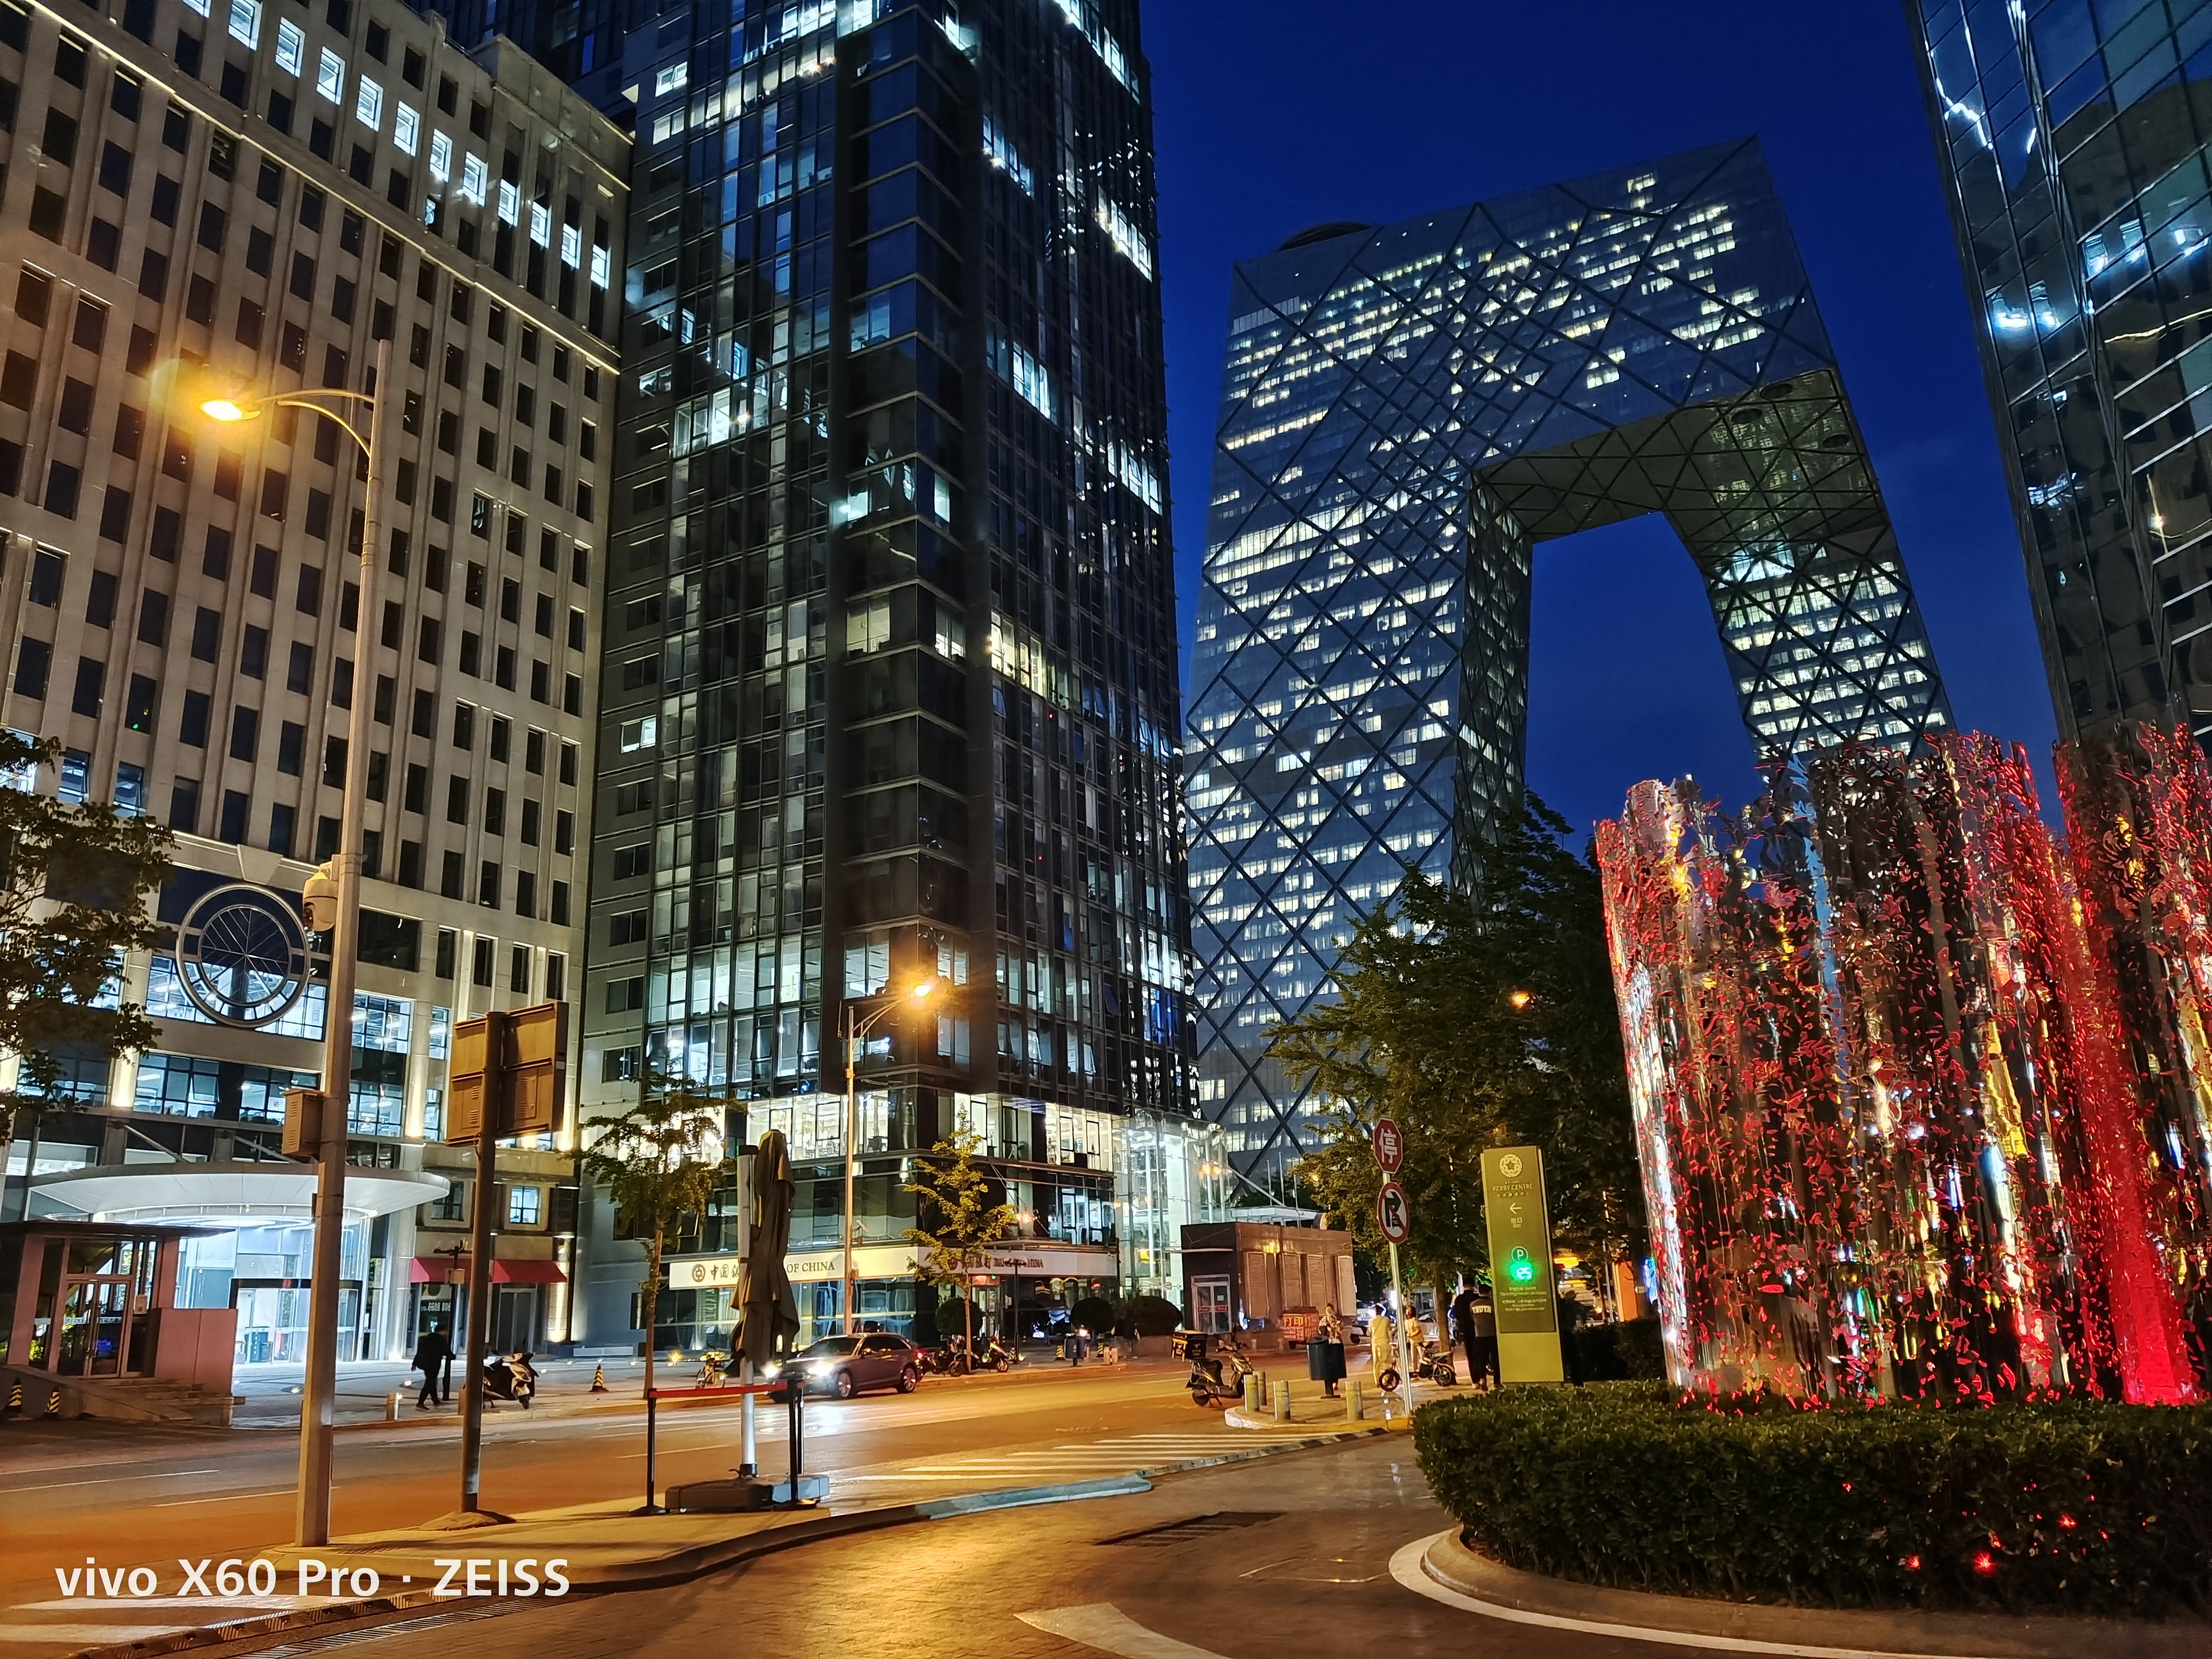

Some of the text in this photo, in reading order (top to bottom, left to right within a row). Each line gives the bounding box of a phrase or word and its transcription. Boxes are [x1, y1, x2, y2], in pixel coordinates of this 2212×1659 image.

[1379, 1128, 1399, 1164] 停
[1516, 1249, 1525, 1260] P
[786, 1261, 836, 1273] OF CHINA
